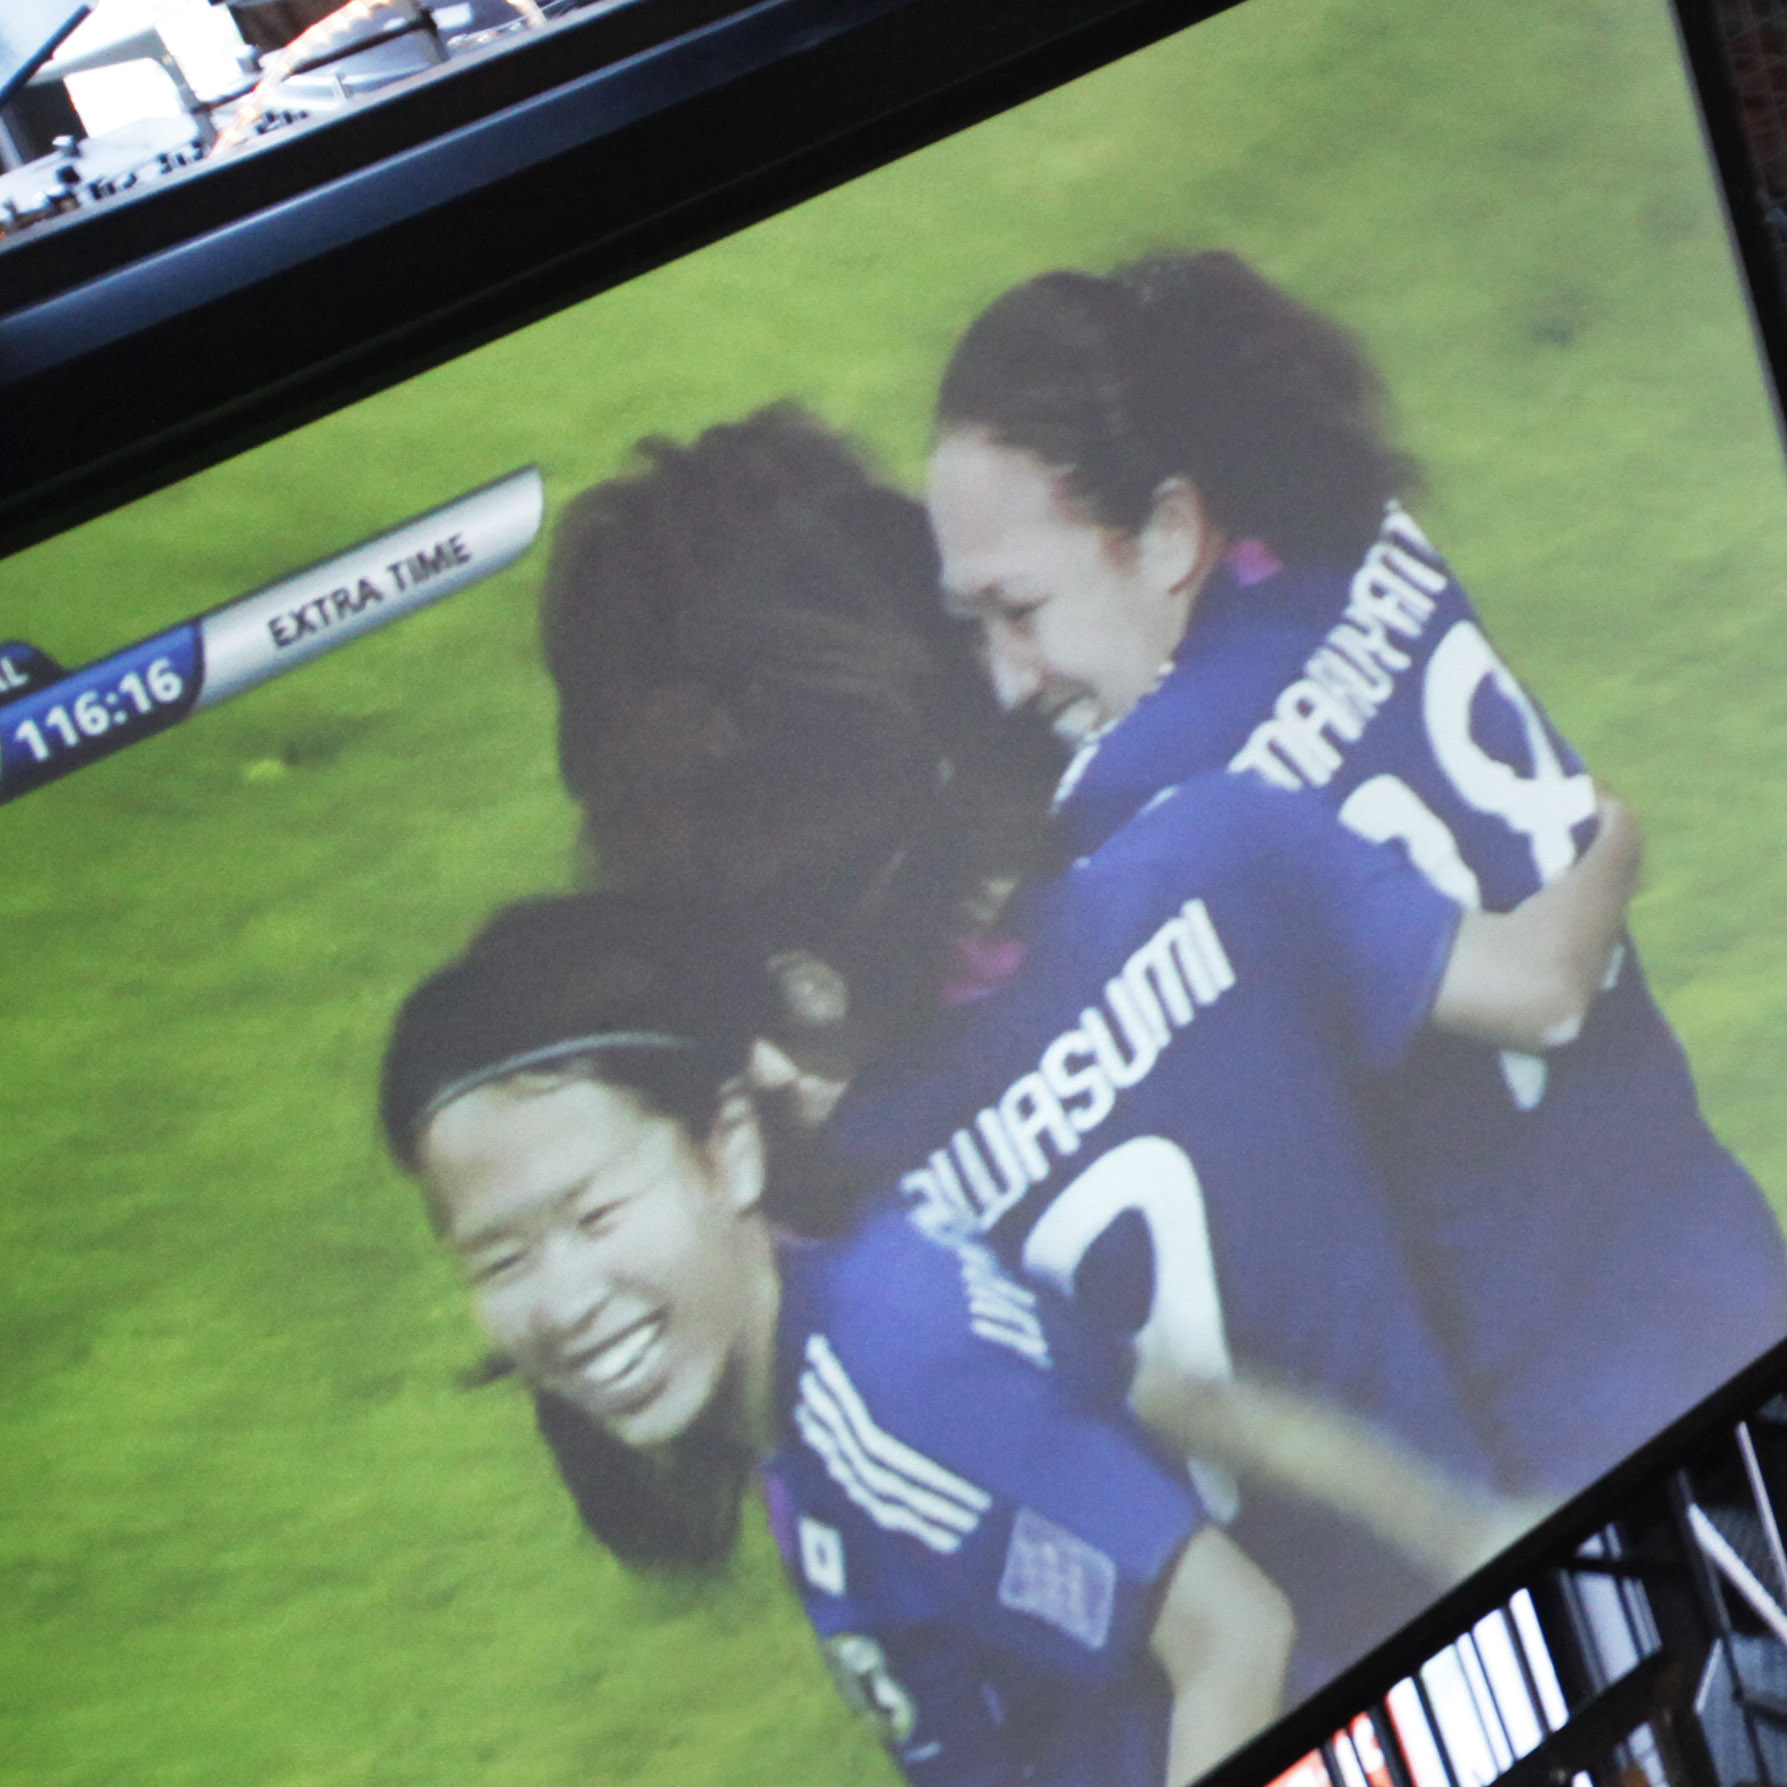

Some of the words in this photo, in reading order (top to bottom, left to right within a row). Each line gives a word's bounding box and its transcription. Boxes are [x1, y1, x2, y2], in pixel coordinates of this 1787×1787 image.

[267, 576, 383, 650] EXTRA
[386, 531, 473, 592] TIME
[14, 657, 184, 763] 116:16
